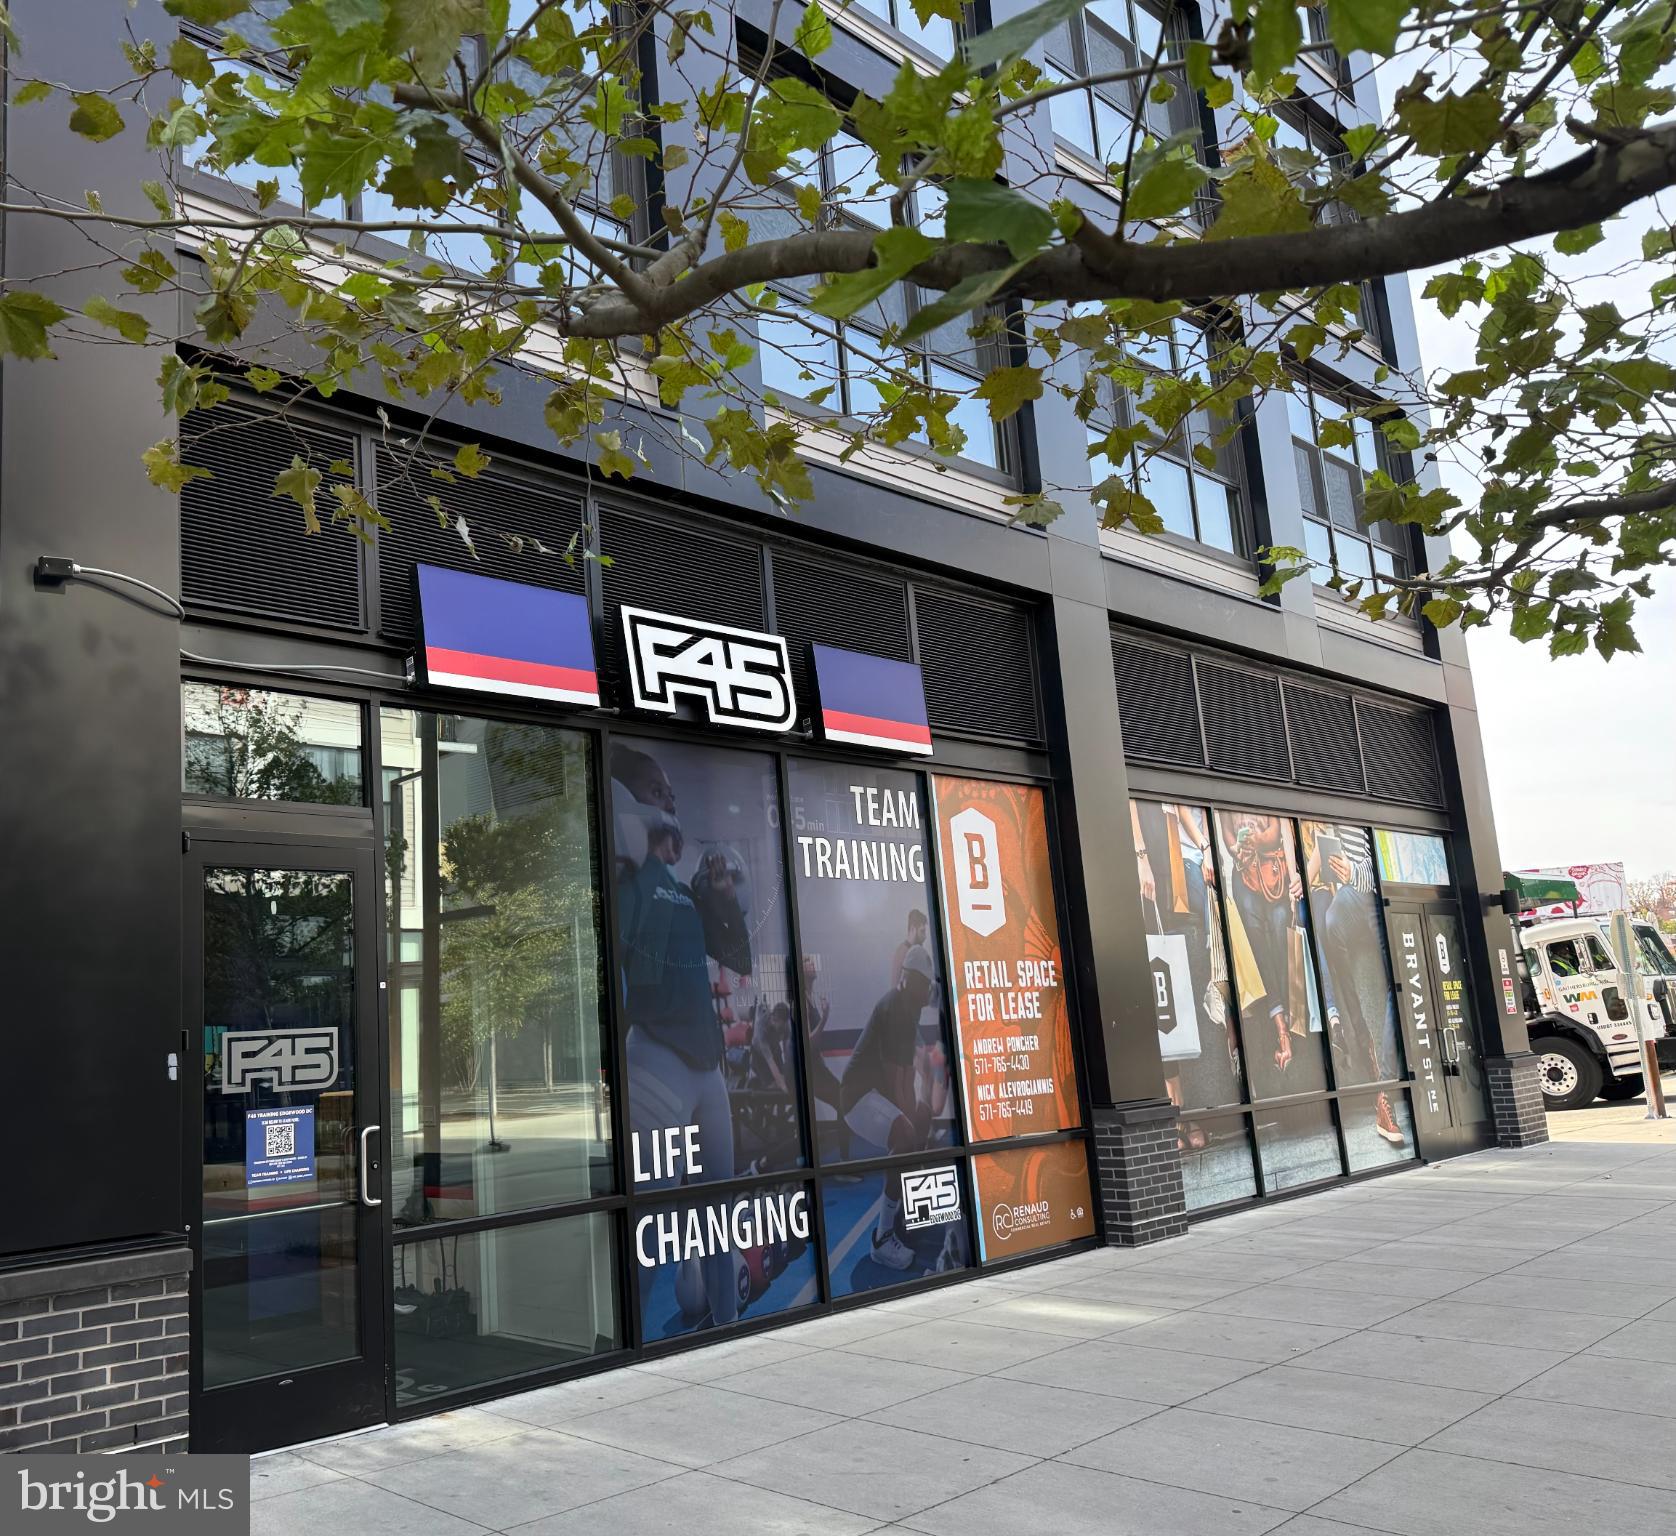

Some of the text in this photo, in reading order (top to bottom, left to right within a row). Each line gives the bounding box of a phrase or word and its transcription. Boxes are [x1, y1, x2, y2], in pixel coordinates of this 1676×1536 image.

[635, 623, 787, 718] F45
[850, 785, 920, 829] TEAM
[798, 836, 925, 883] TRAINING
[964, 832, 989, 890] B
[964, 960, 1058, 989] RETAIL SPACE
[968, 992, 1043, 1022] FOR LEASE
[1563, 991, 1598, 1003] WM
[1402, 932, 1439, 1113] BRYANT ST NE
[231, 1036, 331, 1084] F45
[973, 1035, 1040, 1055] ANDREW PONCHER
[974, 1054, 1030, 1075] 571-765-4430
[977, 1078, 1054, 1101] NICK ALEVROGIANNIS
[980, 1098, 1034, 1120] 571-765-4419
[631, 1124, 703, 1183] LIFE
[905, 1171, 957, 1212] F45
[1013, 1200, 1049, 1218] RENAUD
[635, 1191, 810, 1268] CHANGING
[1014, 1212, 1050, 1226] CONSULTING
